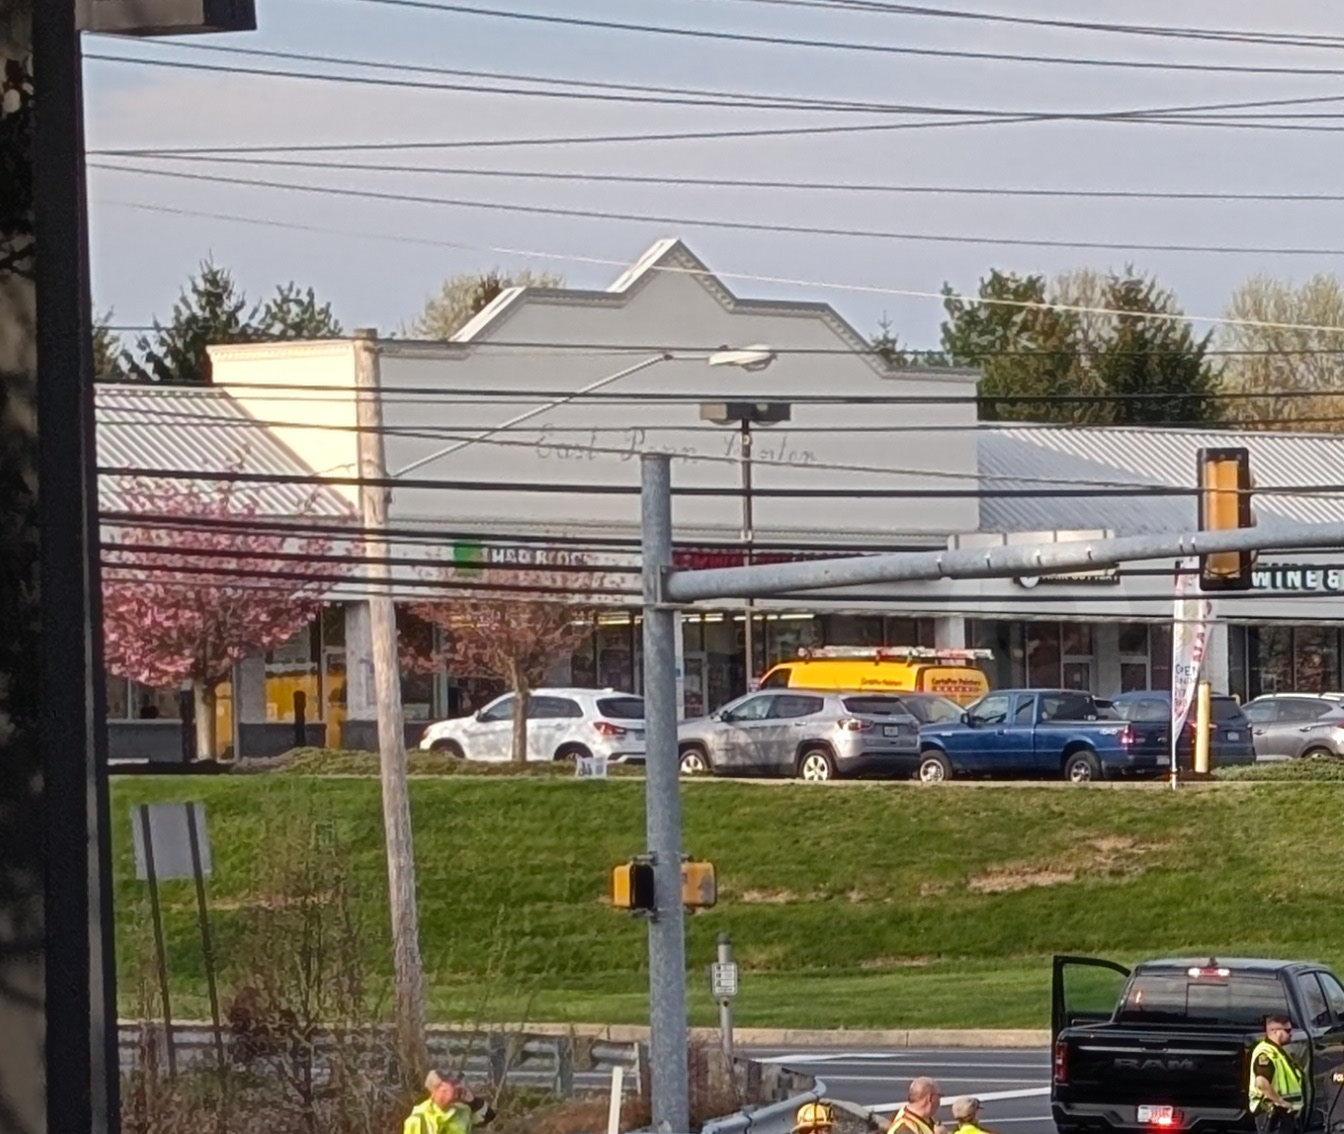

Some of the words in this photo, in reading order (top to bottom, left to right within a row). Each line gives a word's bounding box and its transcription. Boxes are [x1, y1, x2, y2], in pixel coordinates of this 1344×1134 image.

[1251, 570, 1318, 590] WINE
[1327, 568, 1339, 588] &
[1113, 1058, 1194, 1072] RAM
